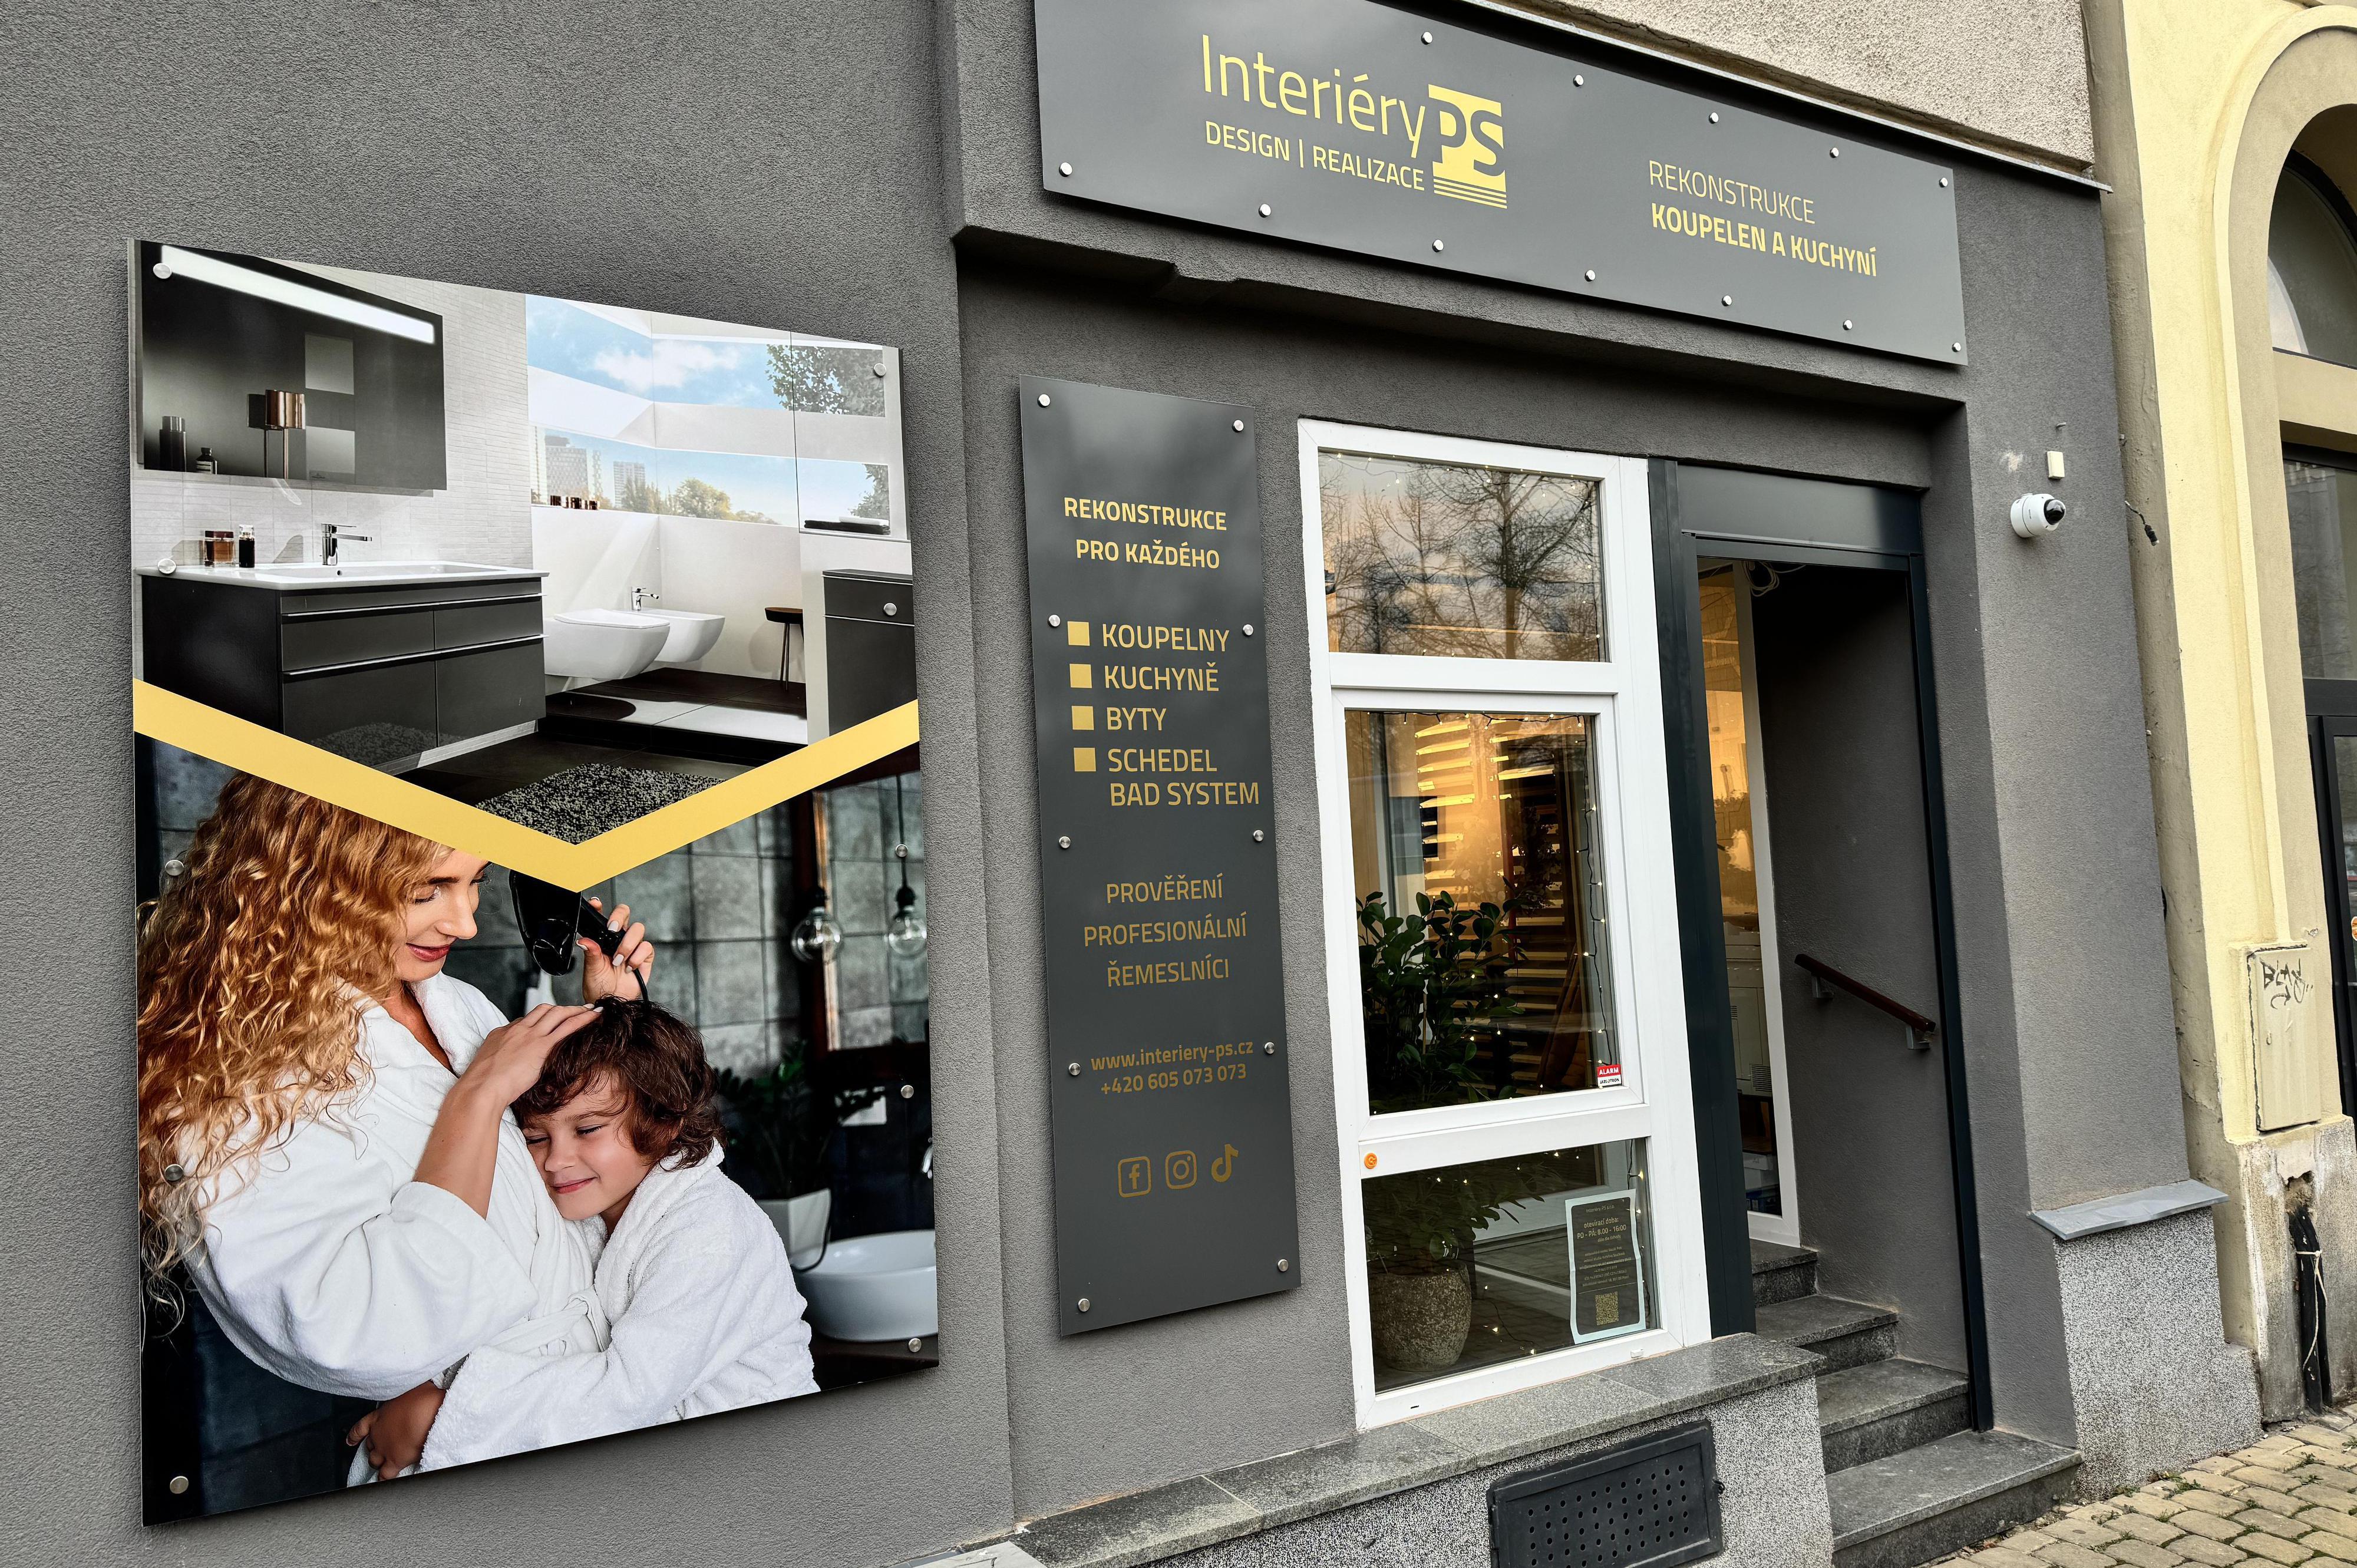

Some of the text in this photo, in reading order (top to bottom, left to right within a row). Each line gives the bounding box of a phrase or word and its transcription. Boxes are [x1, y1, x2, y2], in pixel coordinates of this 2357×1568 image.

[1203, 34, 1507, 193] Interiéry PS
[1206, 121, 1290, 161] DESIGN
[1313, 145, 1425, 191] REALIZACE
[1649, 160, 1815, 225] REKONSTRUKCE
[1652, 202, 1877, 277] KOUPELEN A KUCHYNÍ
[1064, 497, 1227, 530] REKONSTRUKCE
[1076, 539, 1220, 569] PRO KAŽDÉHO
[1102, 623, 1229, 652] KOUPELNY
[1104, 662, 1219, 692] KUCHYNĚ
[1107, 707, 1167, 731] BYTY
[1108, 748, 1217, 773] SCHEDEL
[1110, 782, 1259, 806] BAD SYSTEM
[1107, 873, 1224, 904] PROVĚŘENÍ
[1084, 911, 1247, 947] PROFESIONÁLNÍ
[1107, 953, 1229, 987] ŘEMESLNÍCI
[1091, 1041, 1253, 1071] www.interiery-ps.cz
[1599, 1067, 1619, 1075] ALARM
[1101, 1063, 1246, 1094] +420 605 073 073
